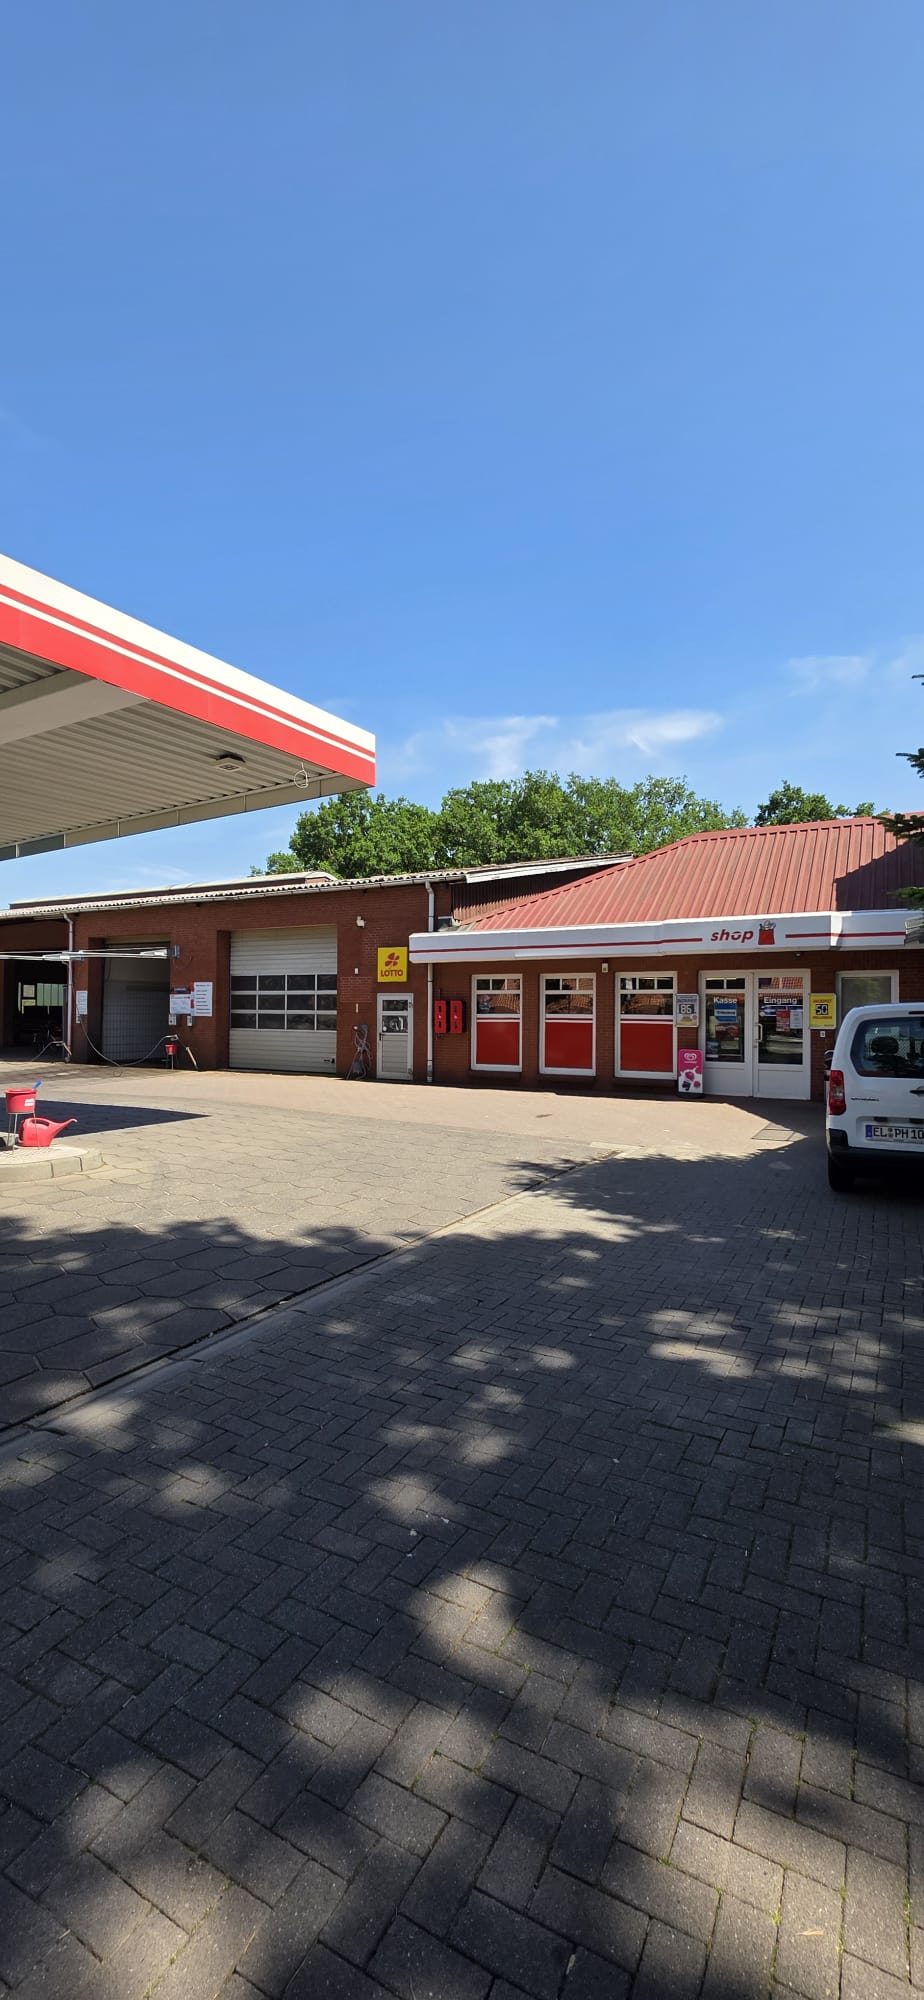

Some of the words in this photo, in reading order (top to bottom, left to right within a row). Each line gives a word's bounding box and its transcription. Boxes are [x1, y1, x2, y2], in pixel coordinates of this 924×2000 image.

[711, 929, 754, 943] shop
[380, 969, 404, 977] LOTTO
[816, 1005, 828, 1015] 50
[873, 1127, 887, 1137] EL
[895, 1128, 909, 1138] PH
